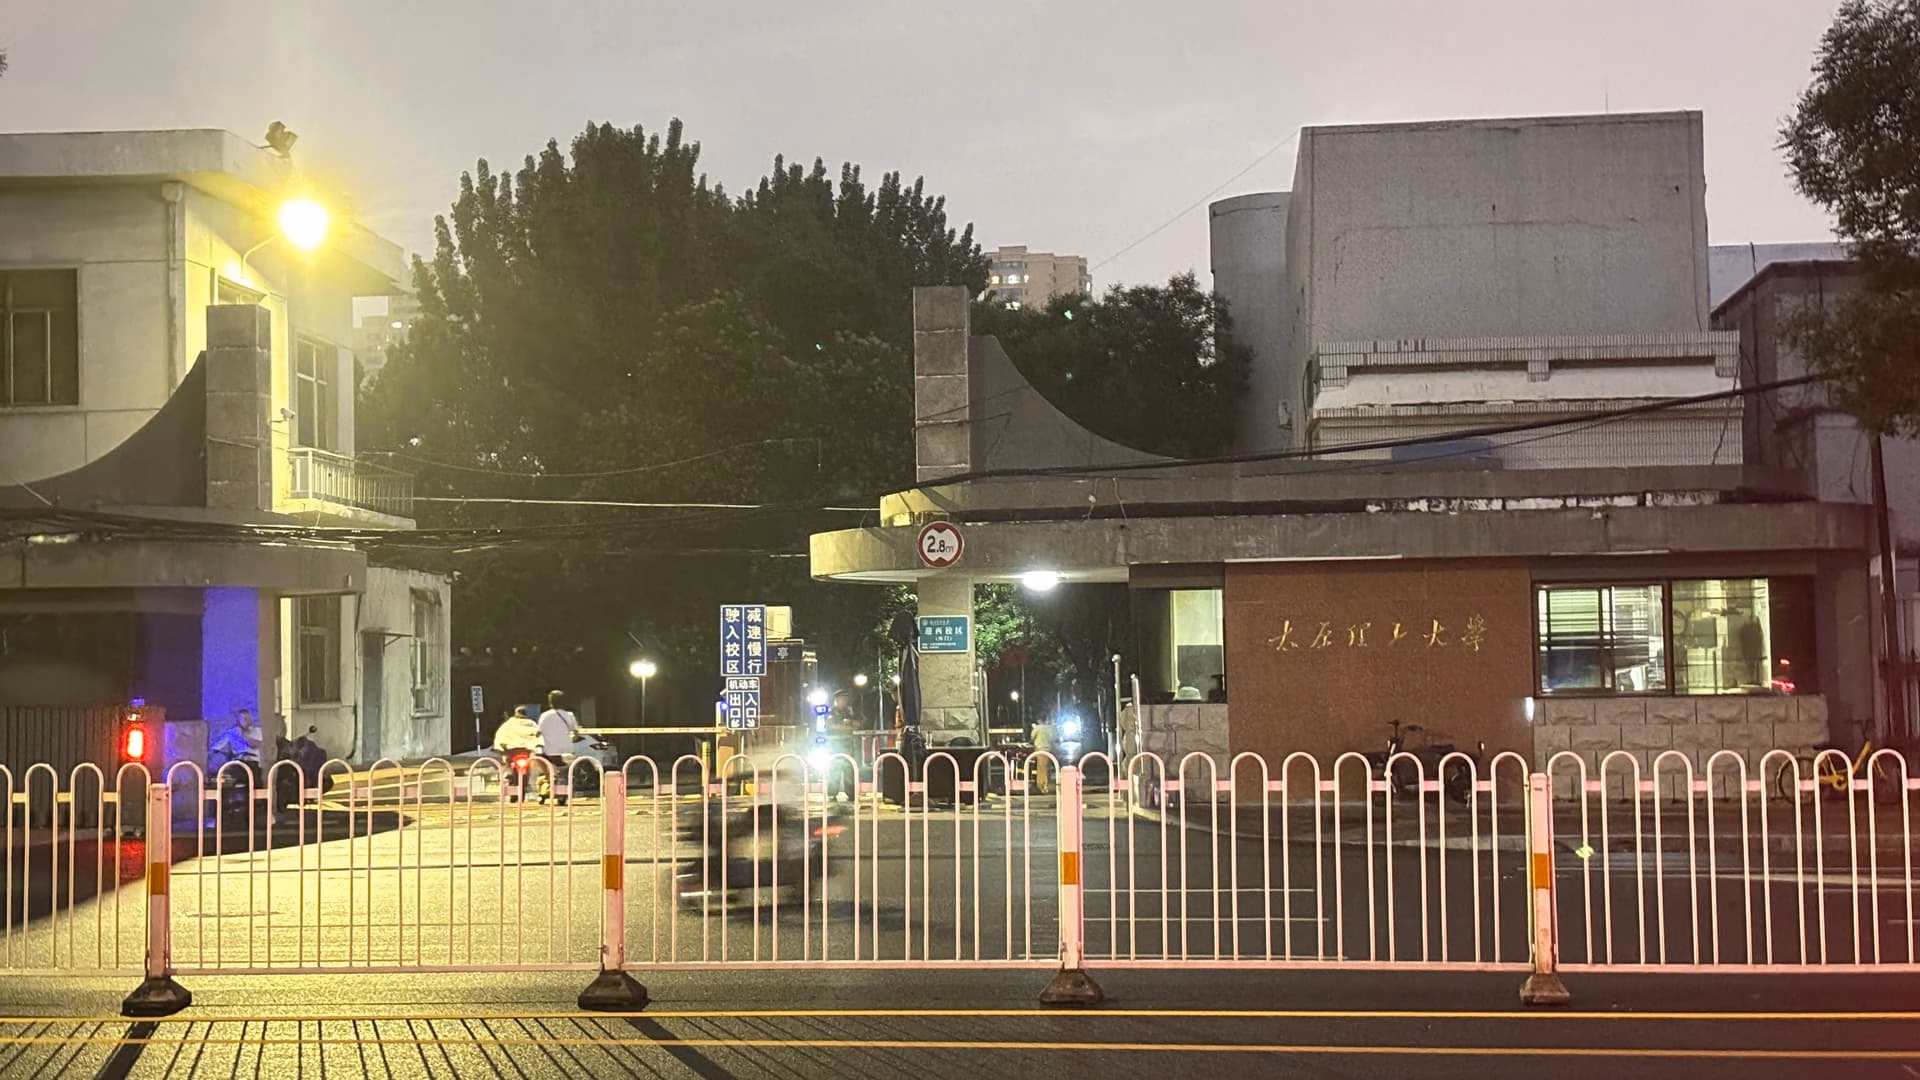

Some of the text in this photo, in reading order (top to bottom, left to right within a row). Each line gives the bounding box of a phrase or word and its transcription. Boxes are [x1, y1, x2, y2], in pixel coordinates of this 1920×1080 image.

[725, 607, 740, 674] 驶入校区
[747, 607, 762, 674] 减速慢行
[729, 680, 758, 690] 机动车
[729, 693, 741, 718] 出口
[745, 693, 758, 718] 入口
